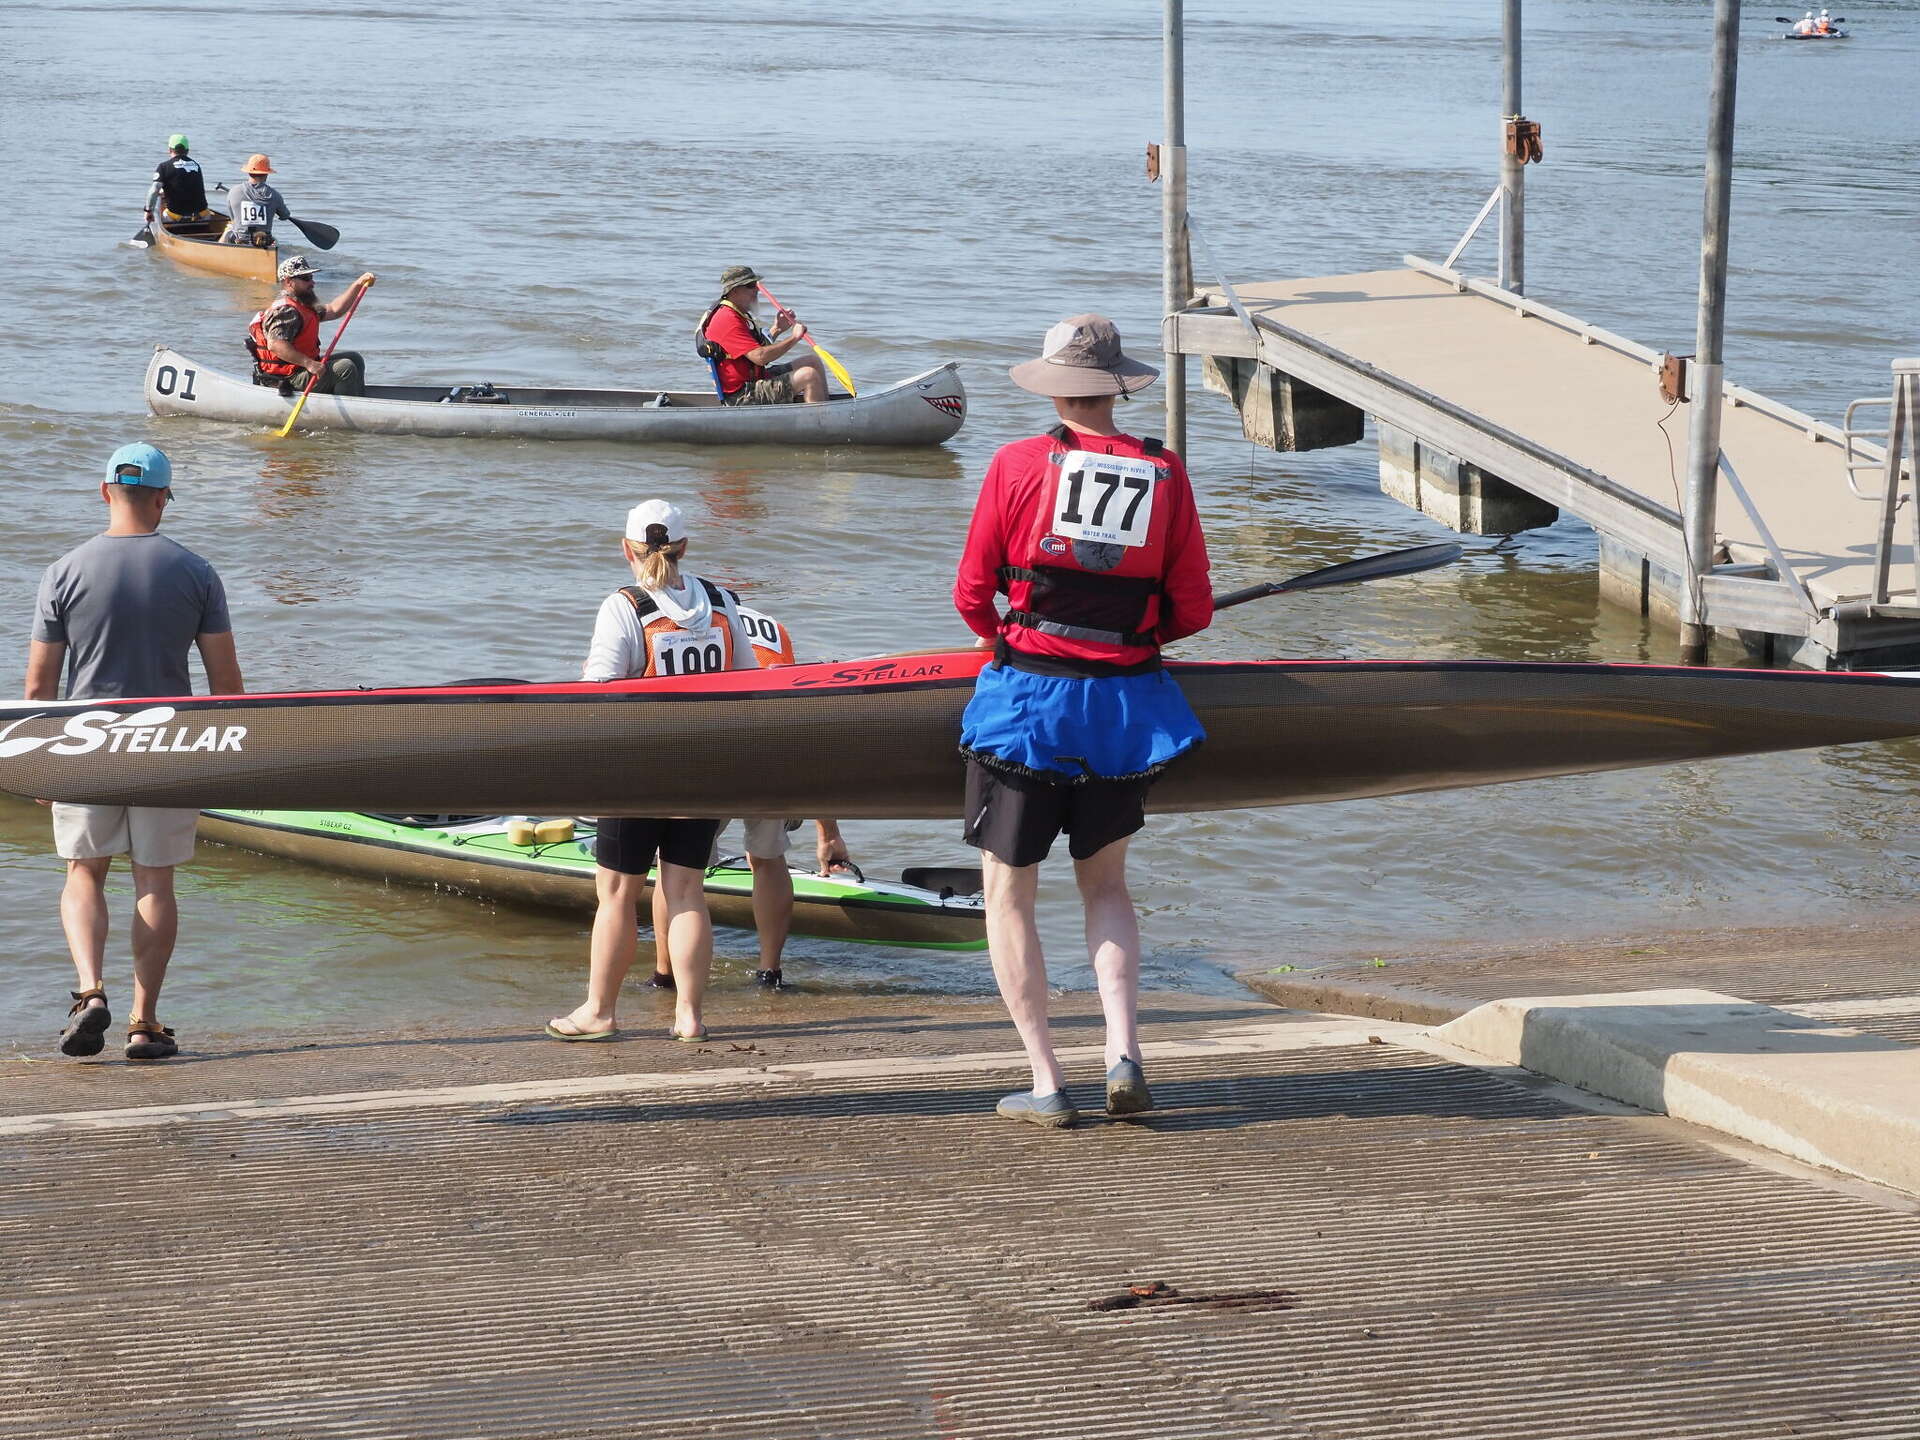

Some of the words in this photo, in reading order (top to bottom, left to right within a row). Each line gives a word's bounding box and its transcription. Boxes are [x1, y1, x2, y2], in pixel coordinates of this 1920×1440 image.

[243, 204, 265, 221] 194
[156, 365, 196, 401] 01
[1061, 469, 1150, 532] 177
[827, 664, 944, 683] STELLAR
[48, 709, 248, 756] STELLAR
